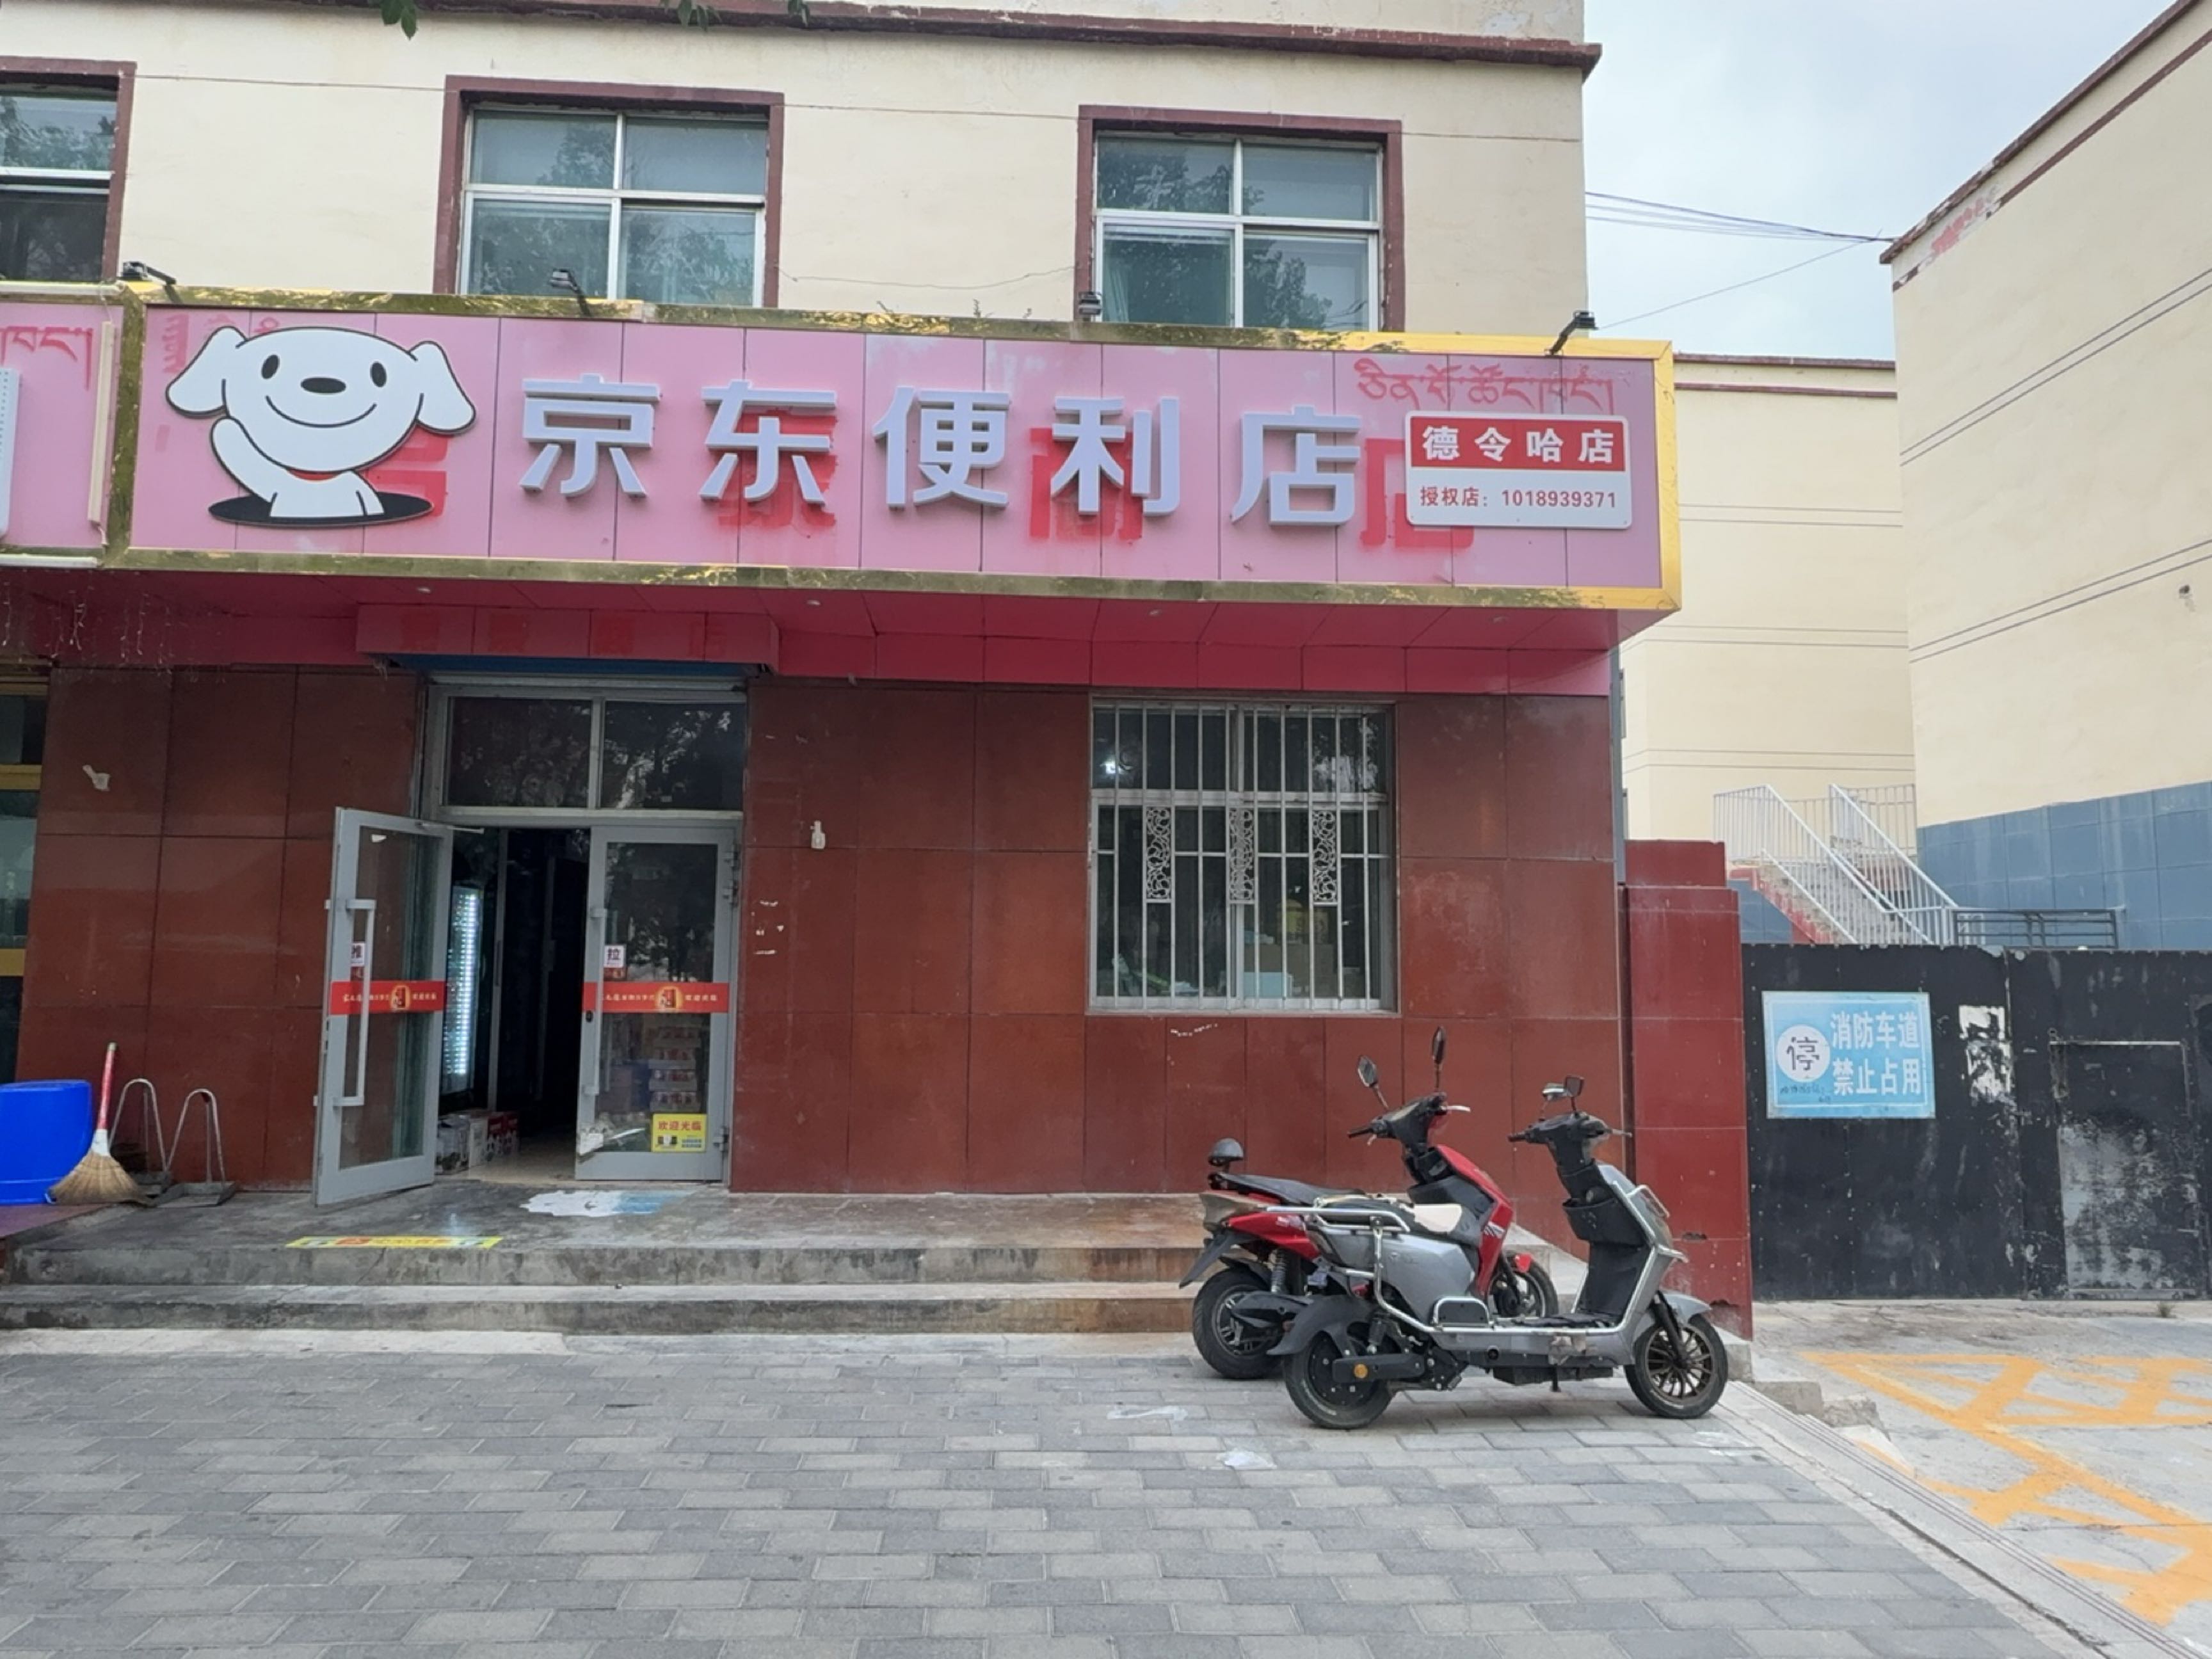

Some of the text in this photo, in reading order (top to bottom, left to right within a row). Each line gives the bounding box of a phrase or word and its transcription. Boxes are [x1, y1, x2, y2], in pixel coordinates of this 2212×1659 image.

[520, 373, 1362, 526] 京东便利店
[1422, 426, 1614, 463] 德令哈店
[1831, 1011, 1918, 1050] 消防车道
[1786, 1036, 1820, 1071] 停
[1832, 1057, 1920, 1095] 禁止占用
